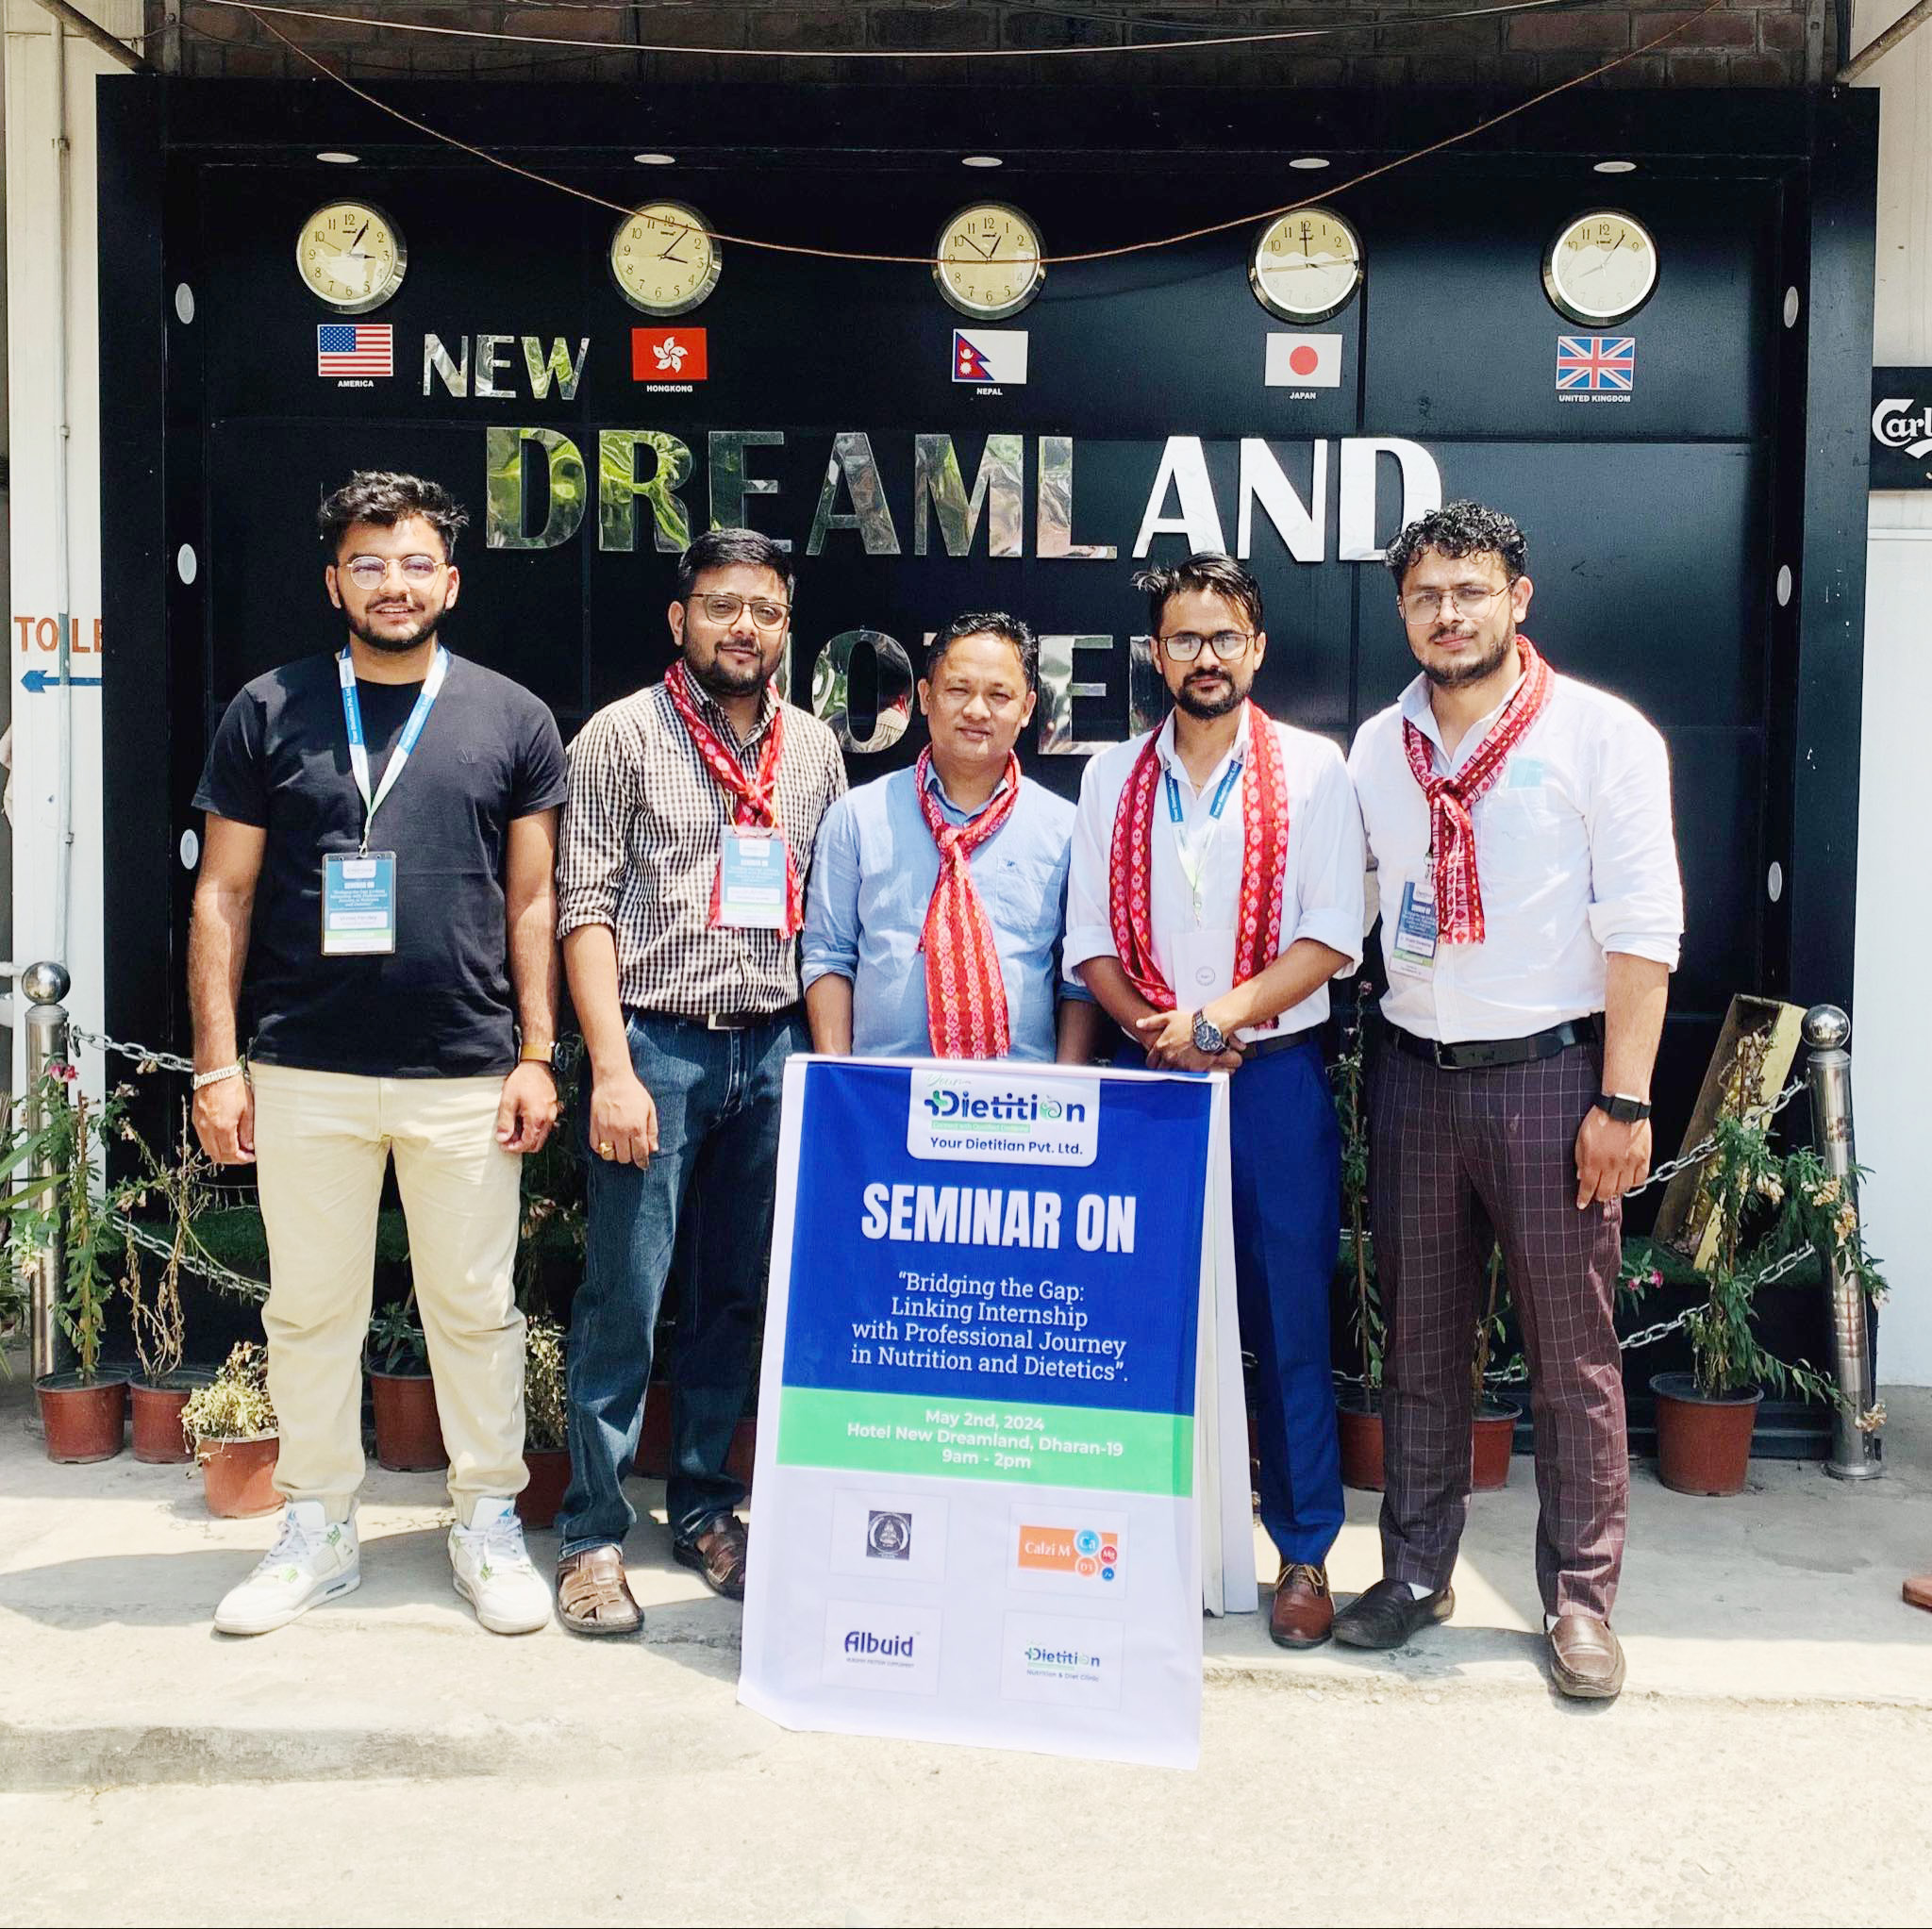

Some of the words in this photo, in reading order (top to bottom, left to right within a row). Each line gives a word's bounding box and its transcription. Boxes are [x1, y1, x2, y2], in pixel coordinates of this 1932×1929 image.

[328, 218, 337, 230] 11
[344, 213, 356, 225] 12
[983, 217, 995, 229] 12
[631, 227, 642, 240] 10
[967, 223, 975, 235] 11
[1284, 227, 1292, 239] 11
[1582, 228, 1591, 241] 11
[1599, 224, 1610, 236] 12
[314, 230, 325, 242] 10
[376, 232, 385, 242] 2
[1017, 235, 1025, 246] 2
[1334, 236, 1342, 247] 2
[624, 244, 631, 257] 9
[1271, 240, 1281, 252] 10
[308, 249, 316, 260] 9
[314, 267, 322, 278] 8
[625, 264, 634, 274] 8
[955, 273, 962, 283] 8
[328, 280, 335, 291] 7
[345, 286, 353, 296] 6
[968, 286, 974, 297] 7
[1004, 286, 1011, 296] 5
[655, 287, 662, 298] 6
[985, 291, 993, 302] 6
[423, 334, 591, 401] NEW
[338, 379, 374, 389] AMERICA
[976, 387, 1003, 396] NEPAL
[1289, 391, 1317, 400] JAPAN
[1558, 394, 1589, 403] UNITED
[1591, 394, 1631, 404] KINGDOM
[486, 426, 1442, 563] DREAMLAND
[930, 1137, 962, 1149] Your
[966, 1138, 1024, 1152] Dietitian
[1029, 1141, 1055, 1153] Pvt.
[1058, 1143, 1083, 1155] Ltd.
[861, 1182, 1062, 1250] SEMINAR
[1075, 1194, 1136, 1254] ON
[1001, 1280, 1033, 1299] the
[1039, 1280, 1085, 1303] Gap:
[891, 1297, 972, 1323] Linking
[978, 1303, 1087, 1330] Internship
[852, 1320, 899, 1341] with
[905, 1322, 1032, 1350] Professional
[1040, 1332, 1126, 1360] Journey
[851, 1344, 872, 1363] in
[878, 1347, 972, 1372] Nutrition
[978, 1354, 1019, 1374] and
[925, 1409, 959, 1427] May
[964, 1411, 998, 1429] 2nd,
[1004, 1415, 1045, 1431] 2024
[847, 1422, 891, 1439] Hotel
[896, 1425, 932, 1443] New
[938, 1429, 1034, 1453] Dreamland,
[1039, 1437, 1123, 1456] Dharan-19
[941, 1449, 979, 1466] 9am
[994, 1452, 1030, 1470] 2pm
[1079, 1536, 1096, 1549] Ca
[1058, 1545, 1071, 1556] M
[844, 1631, 913, 1657] Albuid
